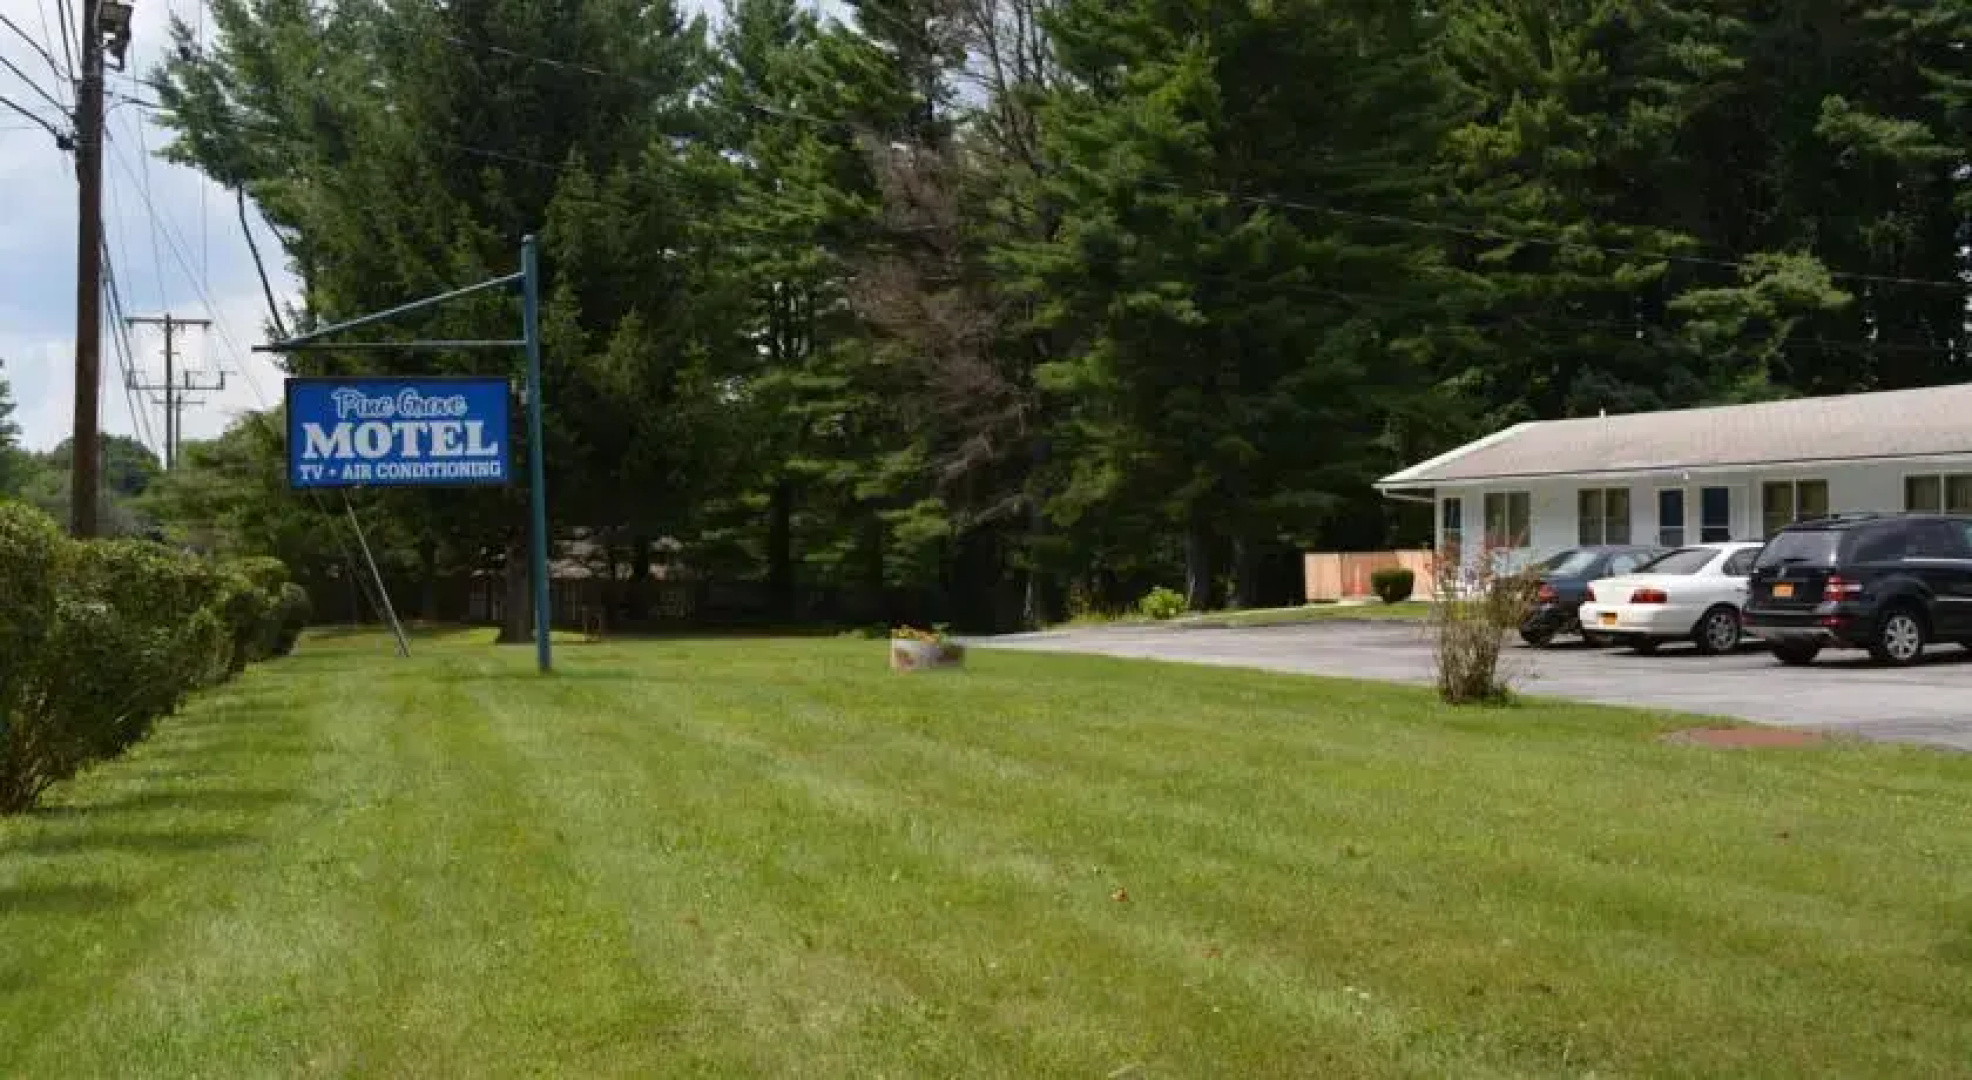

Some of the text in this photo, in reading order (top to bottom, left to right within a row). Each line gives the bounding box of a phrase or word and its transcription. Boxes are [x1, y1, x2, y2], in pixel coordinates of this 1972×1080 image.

[331, 387, 469, 418] Pine Grove
[303, 420, 499, 458] MOTEL
[300, 460, 501, 479] TV AIR CONDITIONING
